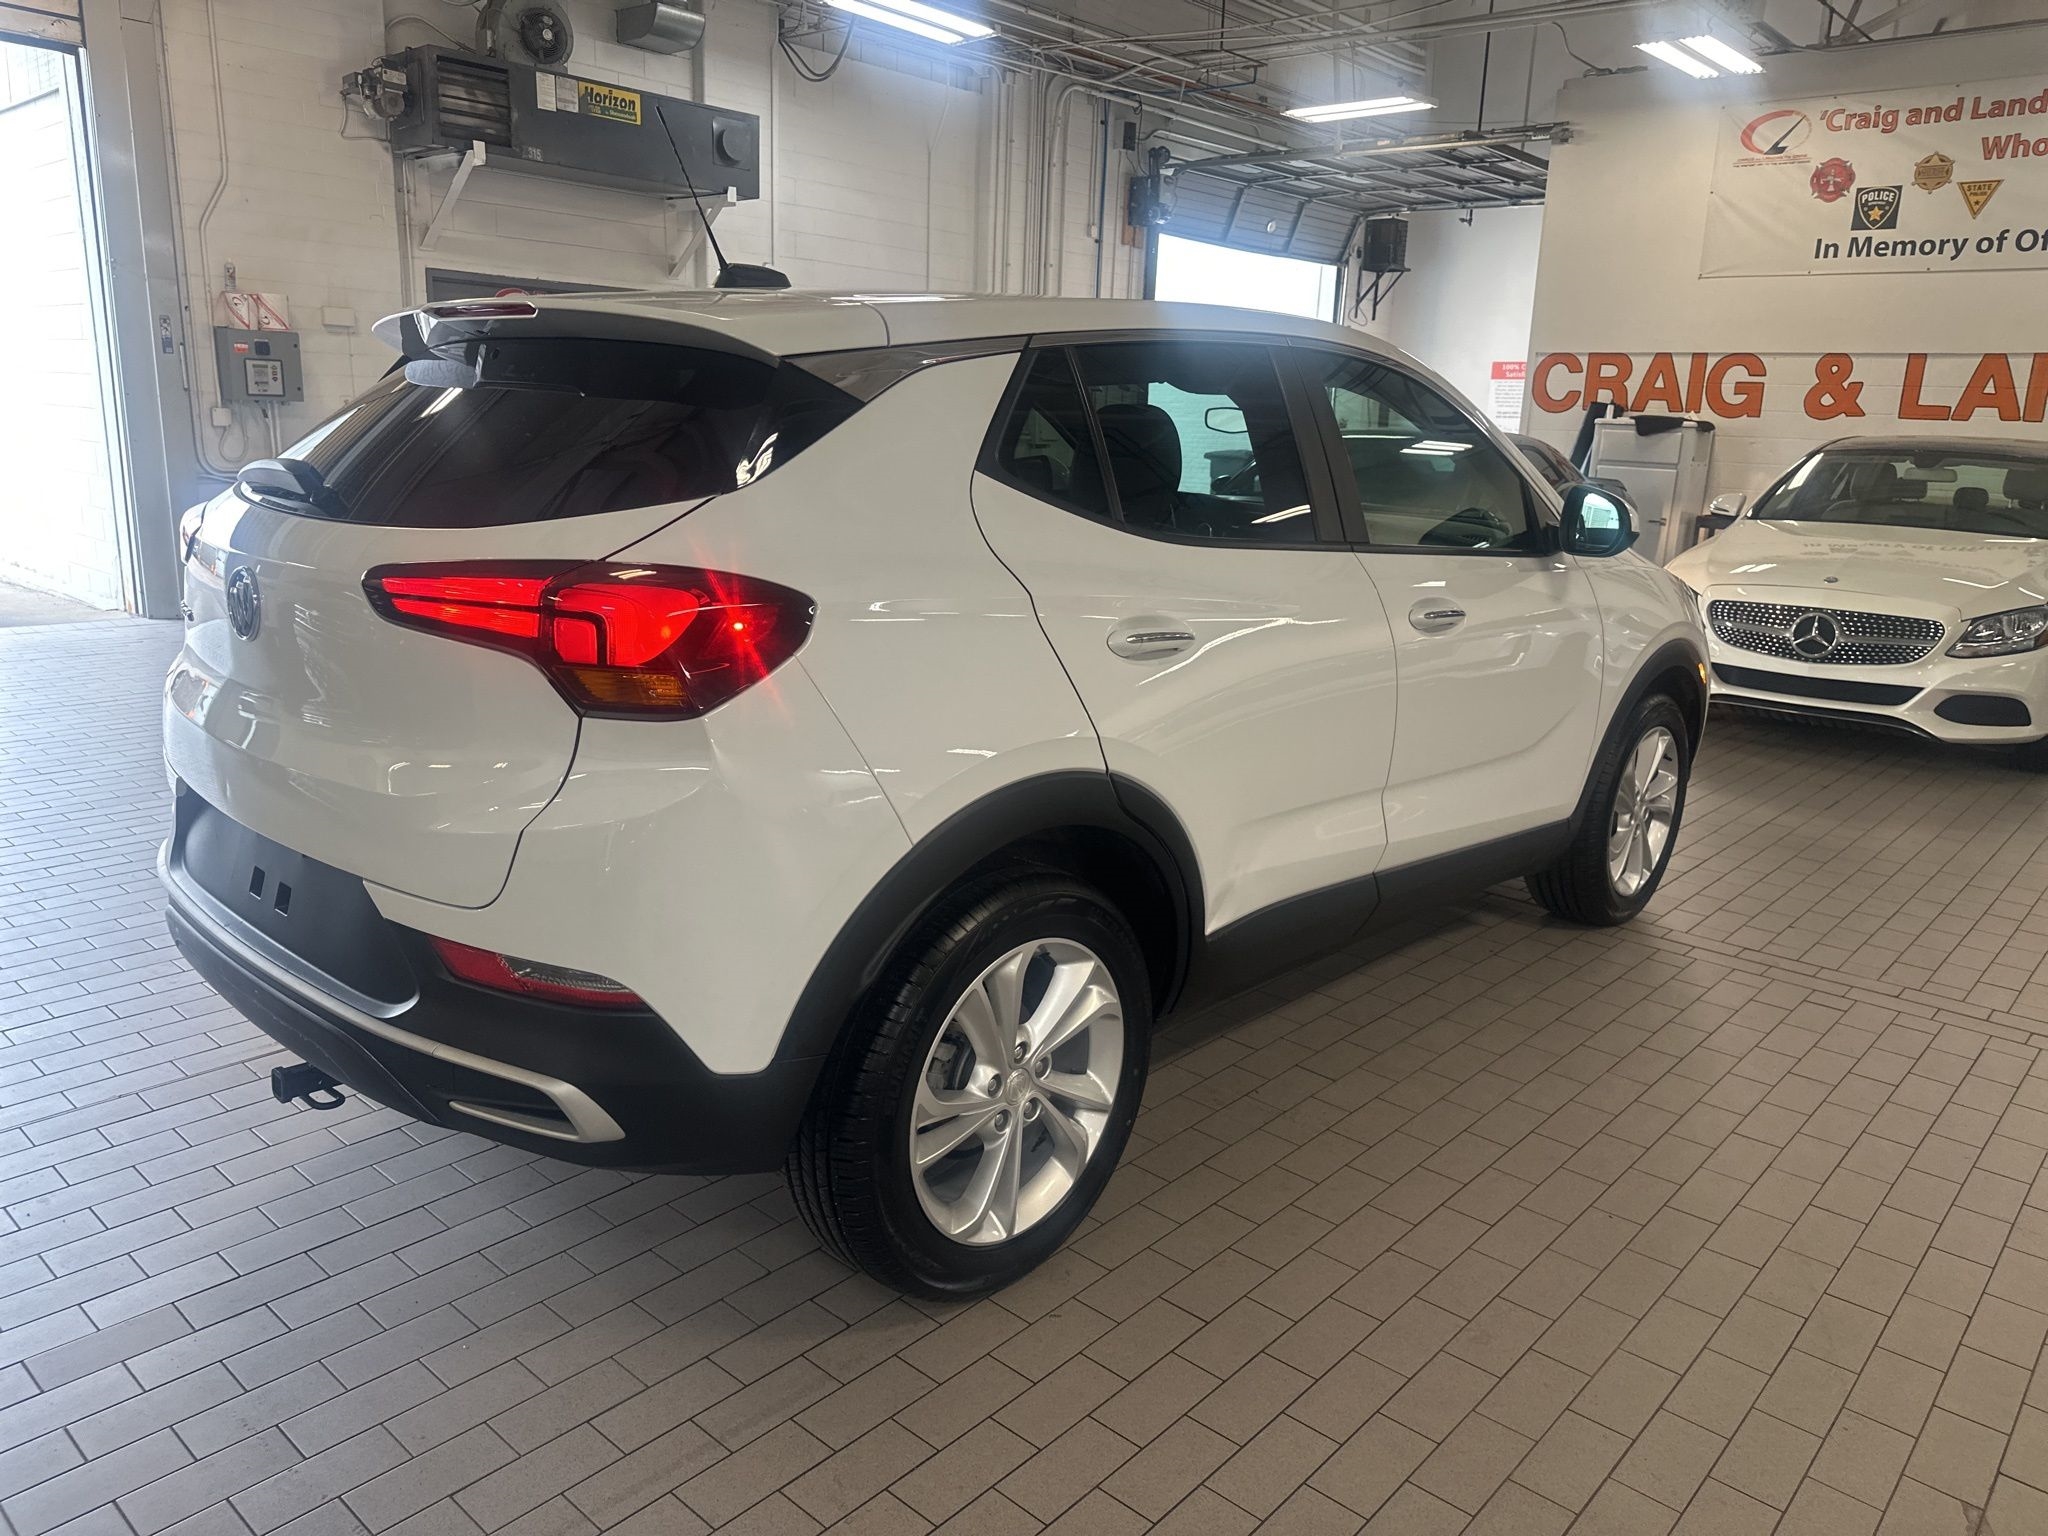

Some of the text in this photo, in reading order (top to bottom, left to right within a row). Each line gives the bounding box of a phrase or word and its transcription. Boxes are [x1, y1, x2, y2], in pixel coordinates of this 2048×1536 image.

[584, 86, 636, 111] Horizon
[1905, 97, 1965, 127] and
[1970, 88, 2048, 120] Land
[1981, 133, 2048, 160] Who
[1861, 190, 1895, 204] POLICE
[1966, 183, 1993, 192] STATE
[1814, 238, 1839, 259] In
[1847, 236, 1969, 261] Memory
[1975, 229, 2011, 254] of
[1531, 352, 1767, 418] CRAIG
[1803, 352, 1865, 420] &
